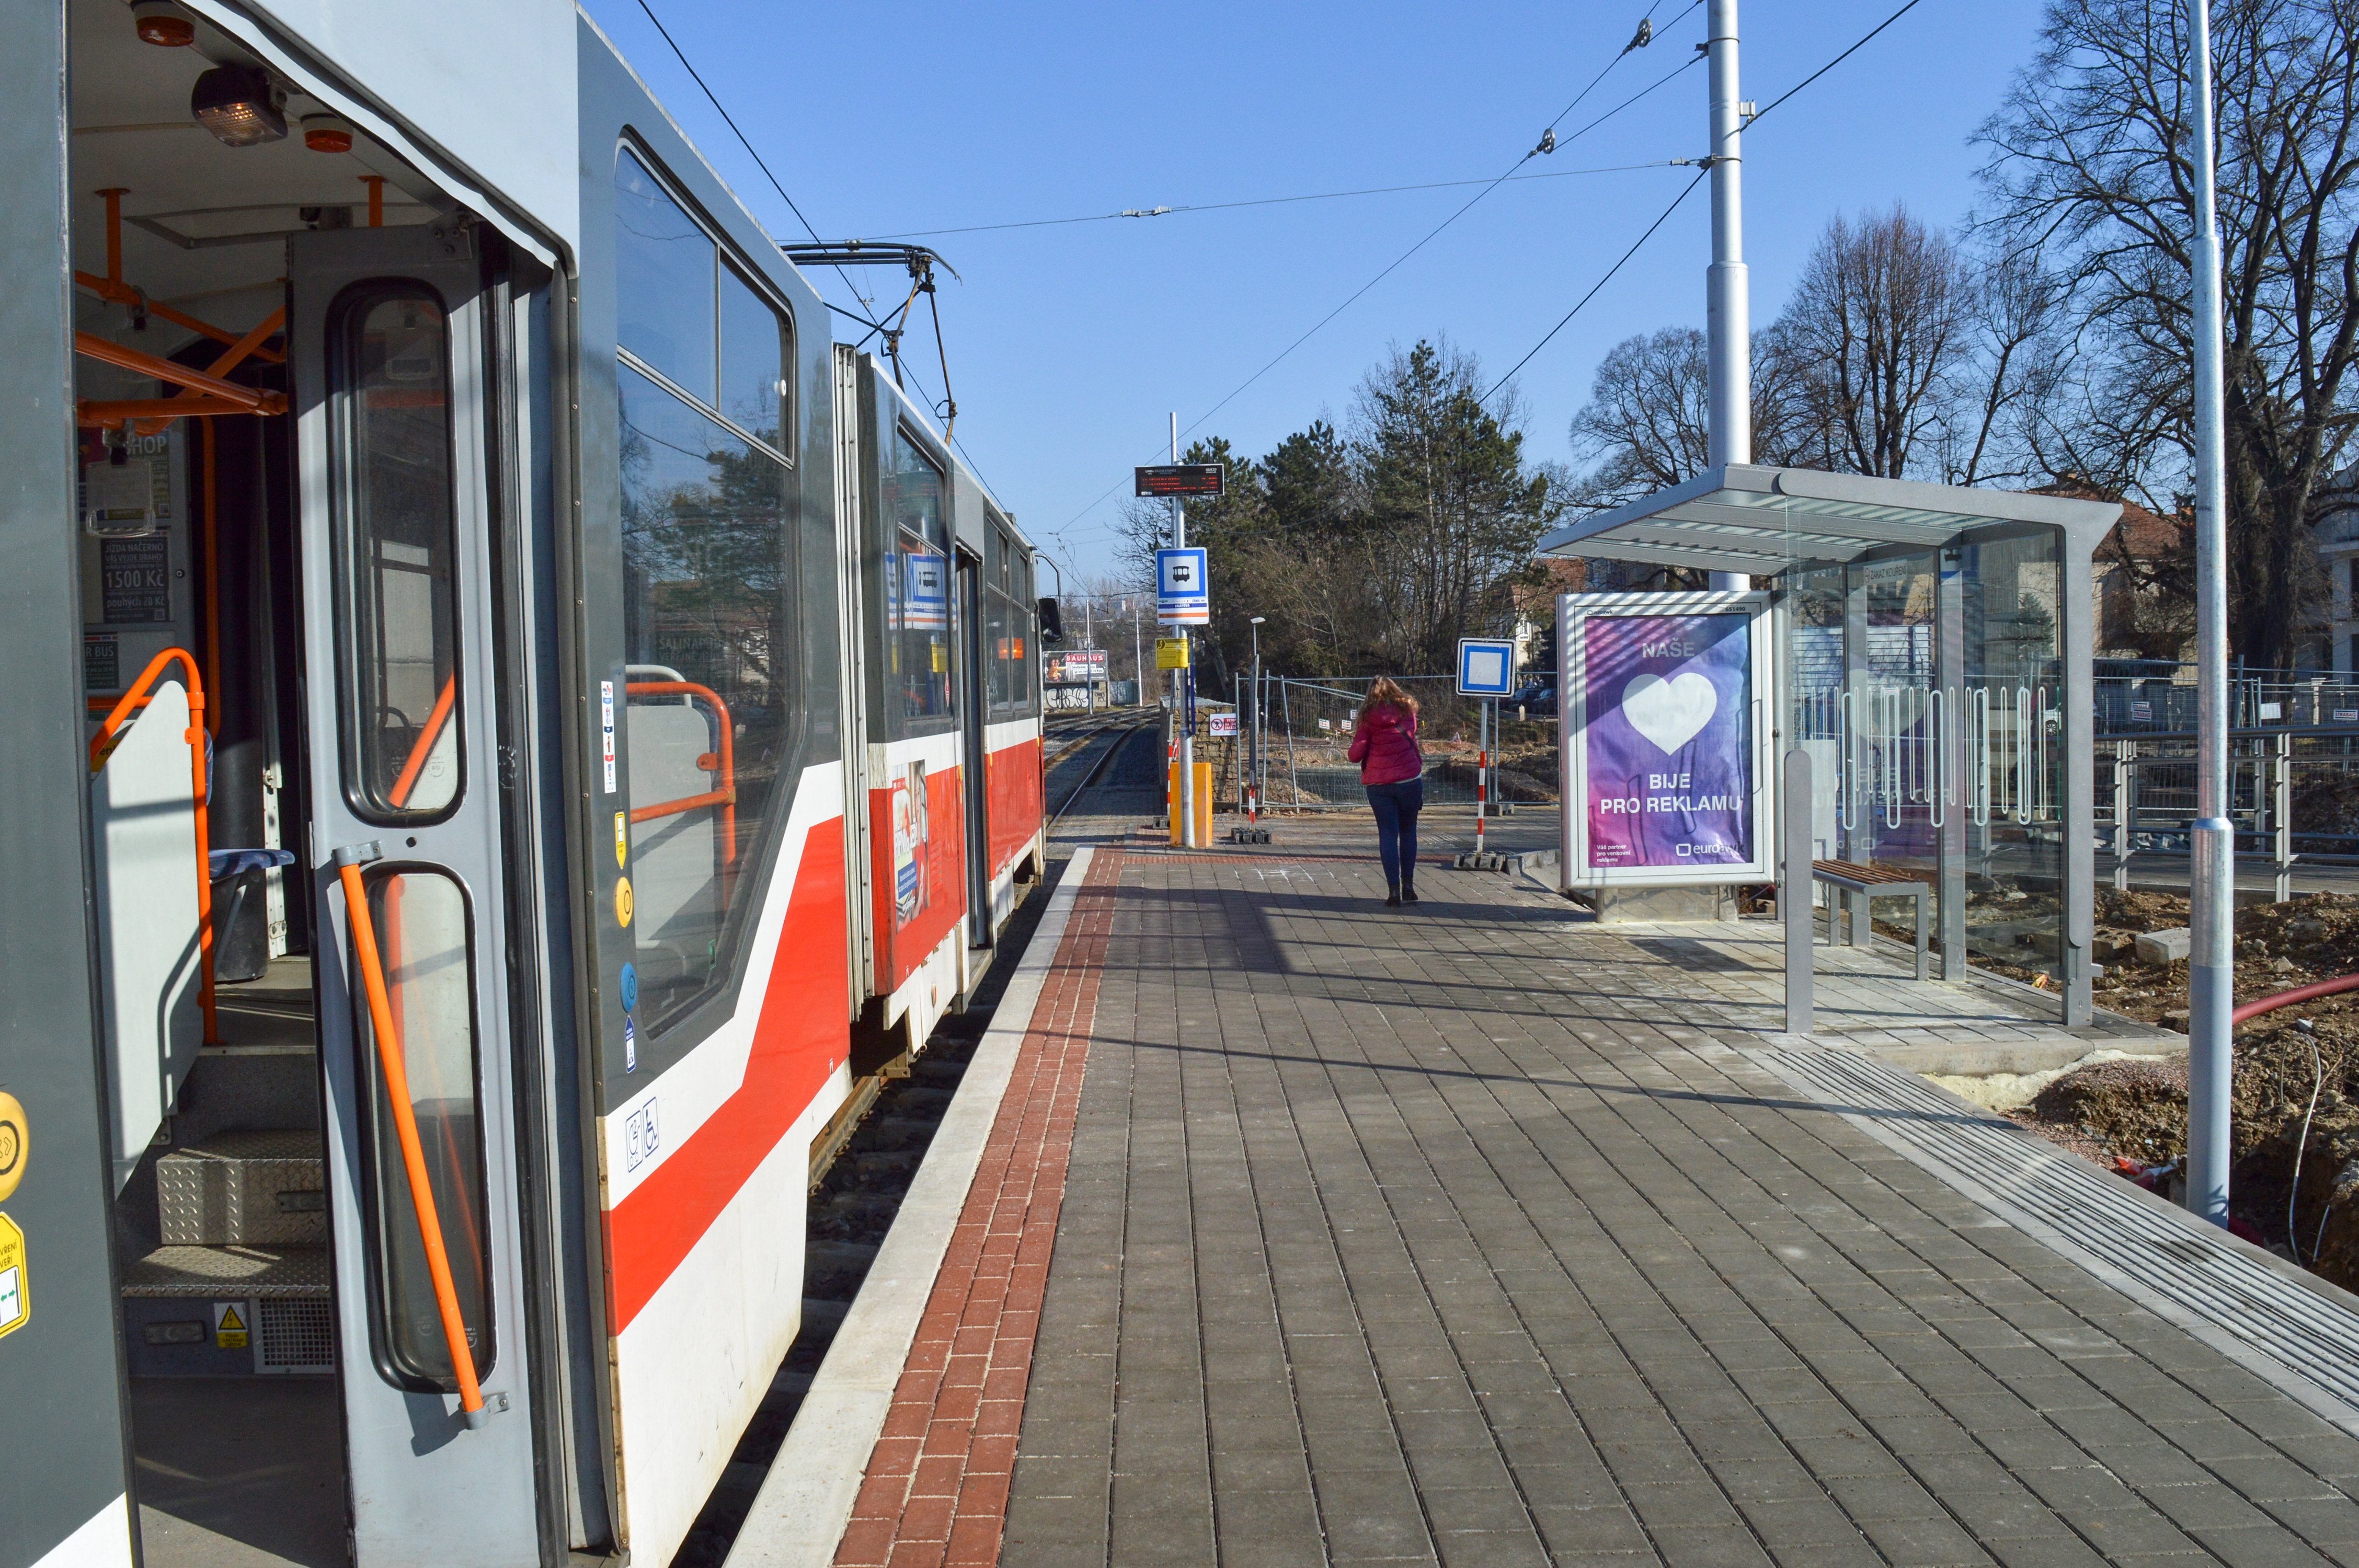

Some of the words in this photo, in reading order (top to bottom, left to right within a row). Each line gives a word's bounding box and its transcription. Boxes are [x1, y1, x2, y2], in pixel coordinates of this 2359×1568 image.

[106, 543, 127, 552] JÍZDA
[128, 541, 163, 552] NAČERNO
[106, 570, 141, 587] 1500
[146, 569, 164, 587] Kč
[107, 596, 141, 608] pouhých
[143, 597, 153, 606] 20
[155, 595, 165, 605] Kč
[95, 645, 114, 657] BUS
[1642, 638, 1694, 658] NAŠE
[1649, 773, 1691, 789] BIJE
[1600, 798, 1641, 814] PRO
[1646, 795, 1741, 813] REKLAMU
[1607, 844, 1627, 852] partner
[1693, 841, 1745, 855] euroawk
